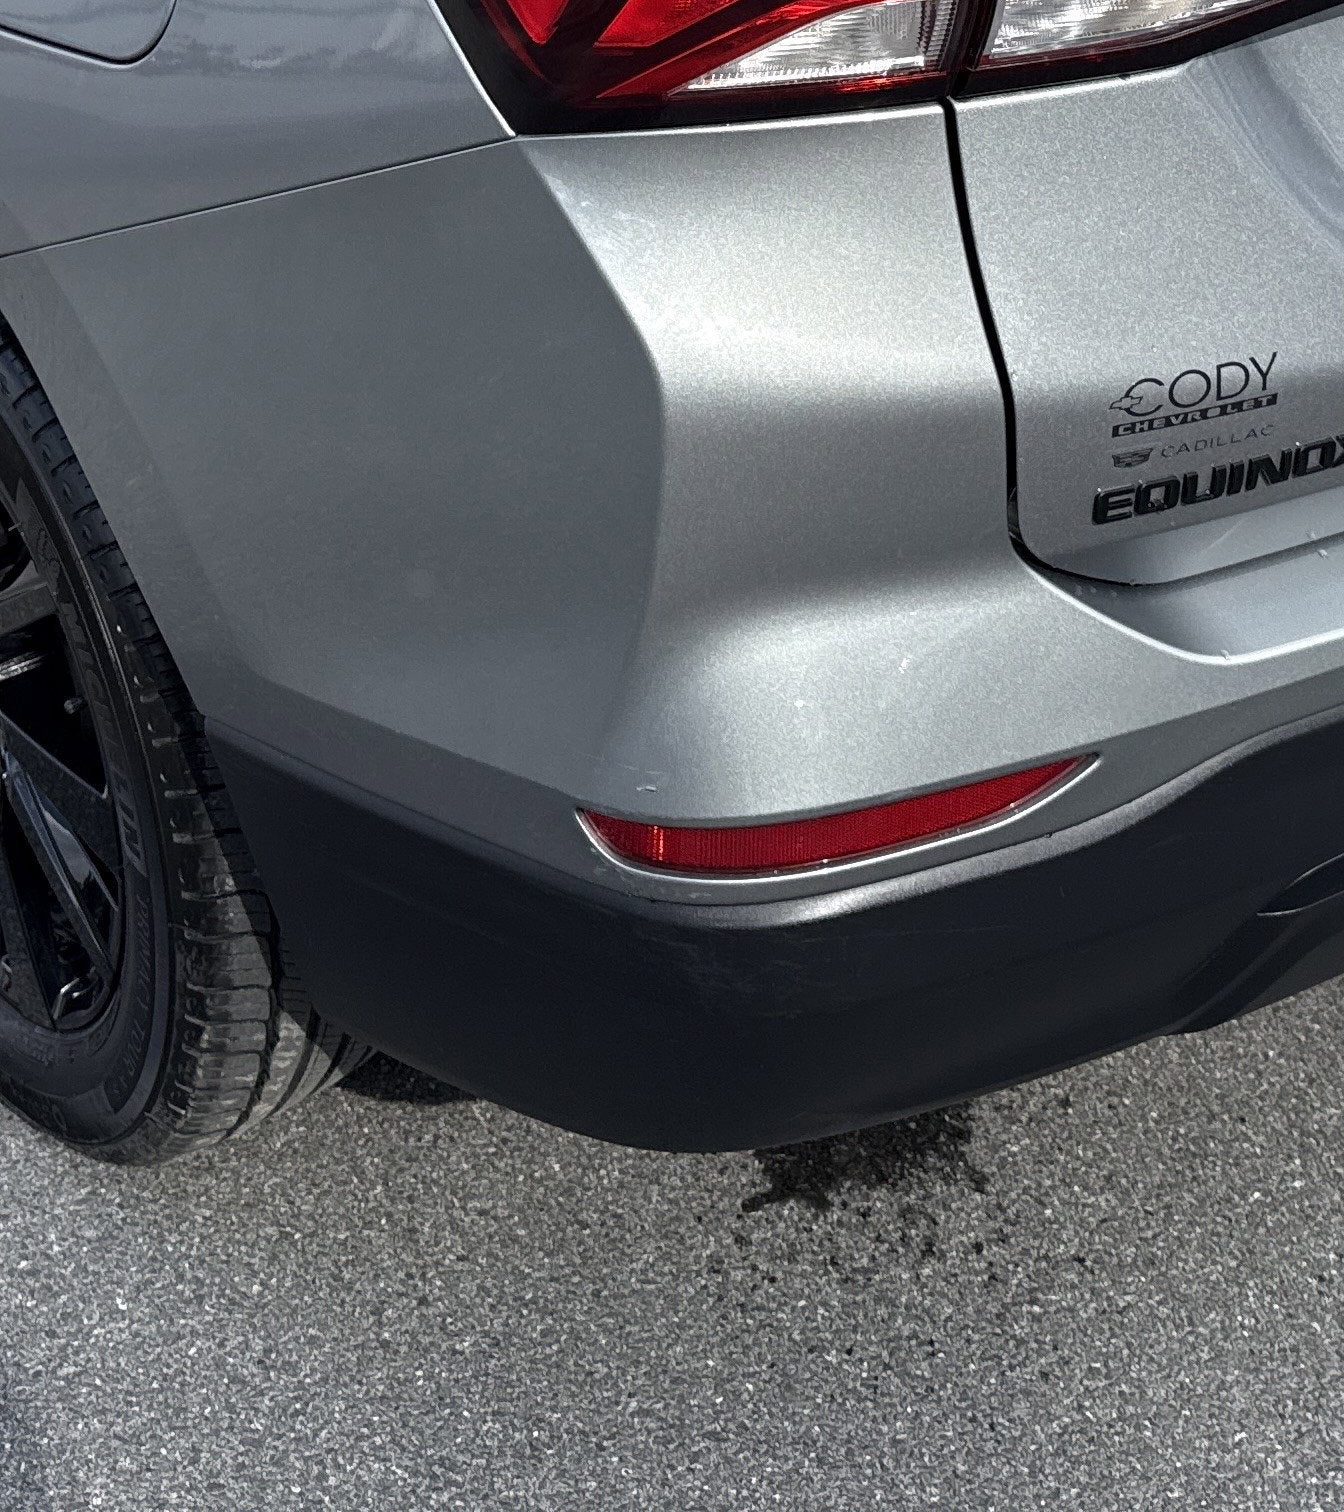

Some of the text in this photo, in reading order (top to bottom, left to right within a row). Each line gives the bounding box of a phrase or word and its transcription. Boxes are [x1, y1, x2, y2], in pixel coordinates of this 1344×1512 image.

[1120, 351, 1278, 417] CODY
[1114, 394, 1278, 437] CHEVROLET
[1161, 424, 1275, 459] CADILLAC
